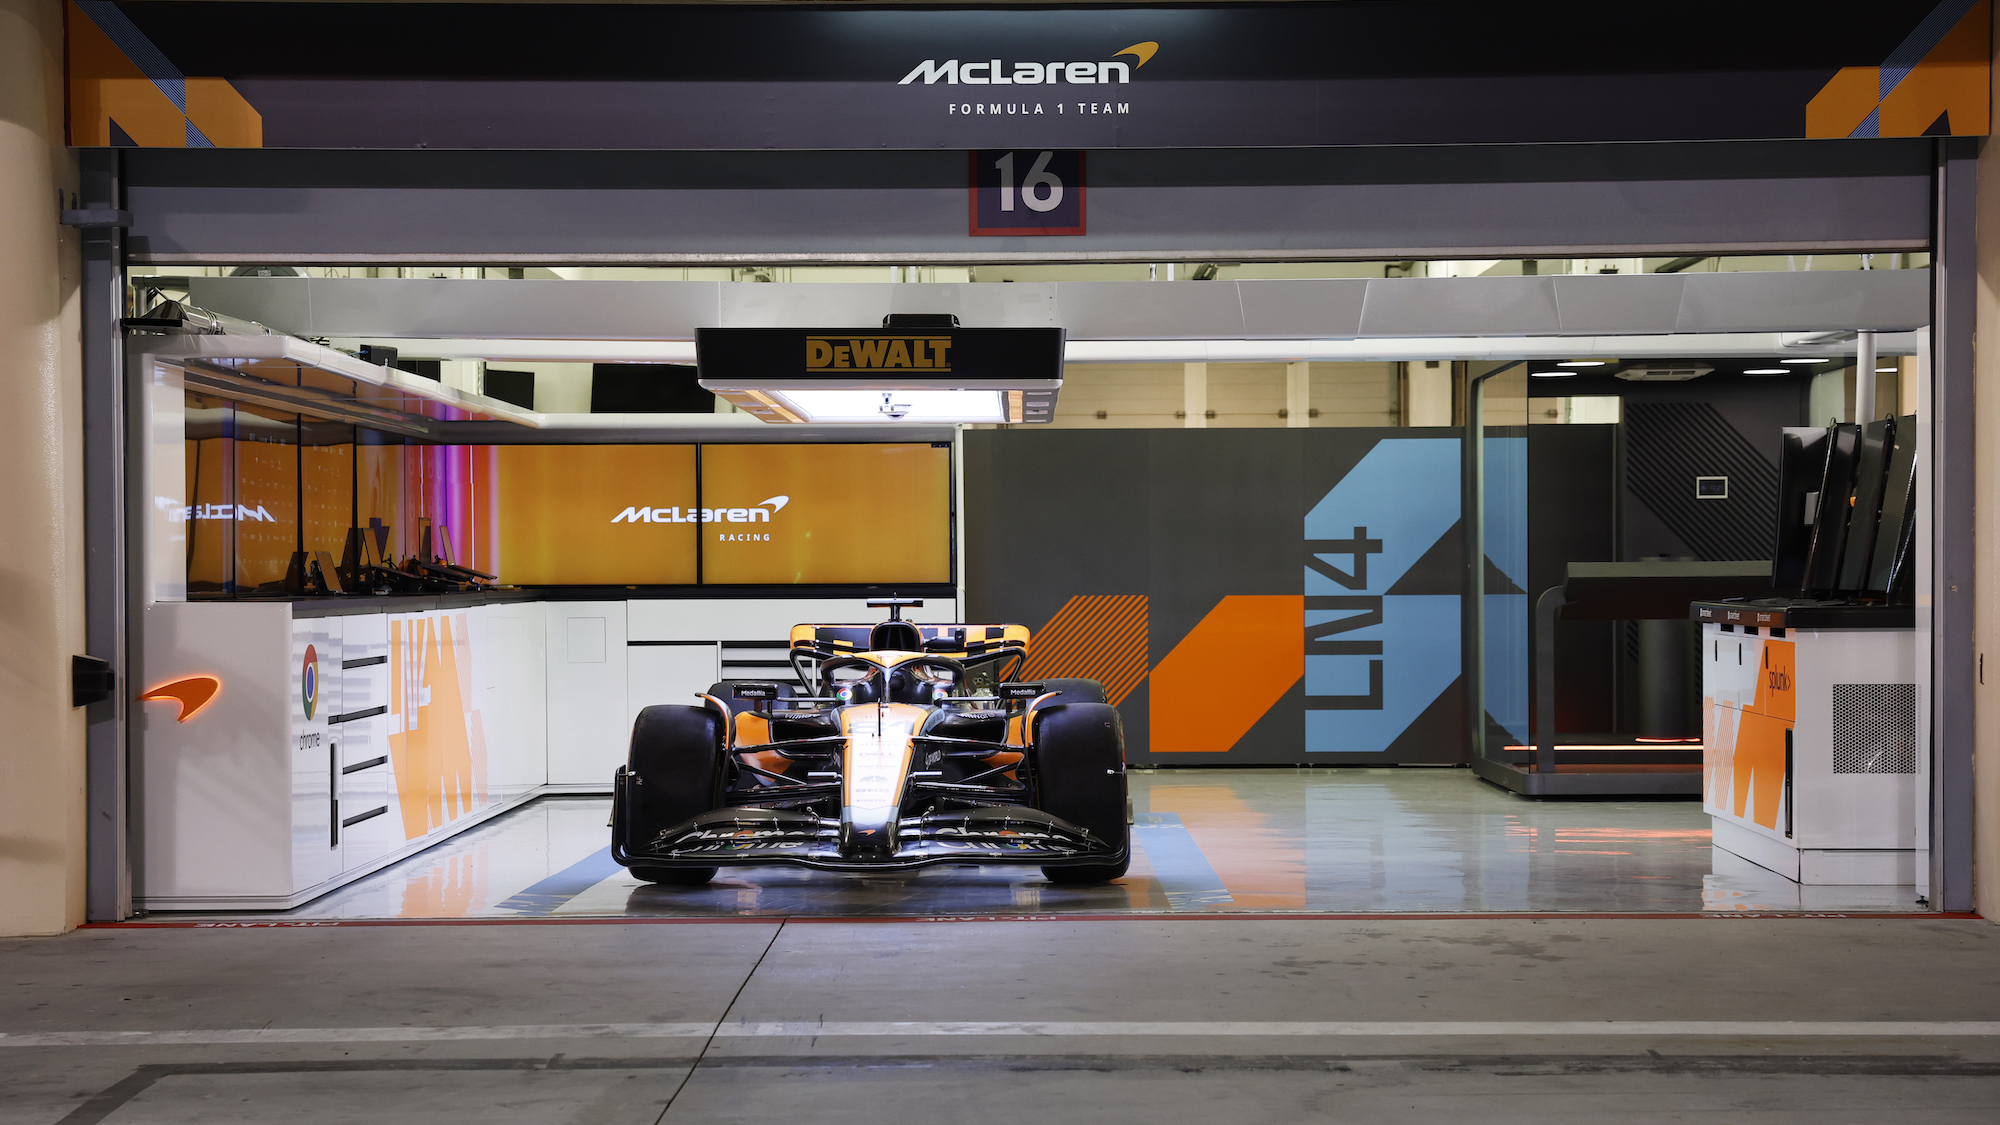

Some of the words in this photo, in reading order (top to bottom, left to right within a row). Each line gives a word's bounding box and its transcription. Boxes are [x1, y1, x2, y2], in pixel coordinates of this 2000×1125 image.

[897, 59, 1129, 85] McLaren
[949, 103, 1044, 115] FORMULA
[1057, 103, 1065, 114] 1
[1078, 102, 1130, 114] TEAM
[995, 151, 1064, 212] 16
[610, 506, 770, 523] McLaren
[719, 533, 770, 542] RACING
[1304, 526, 1383, 710] LN4
[300, 729, 320, 750] chrome
